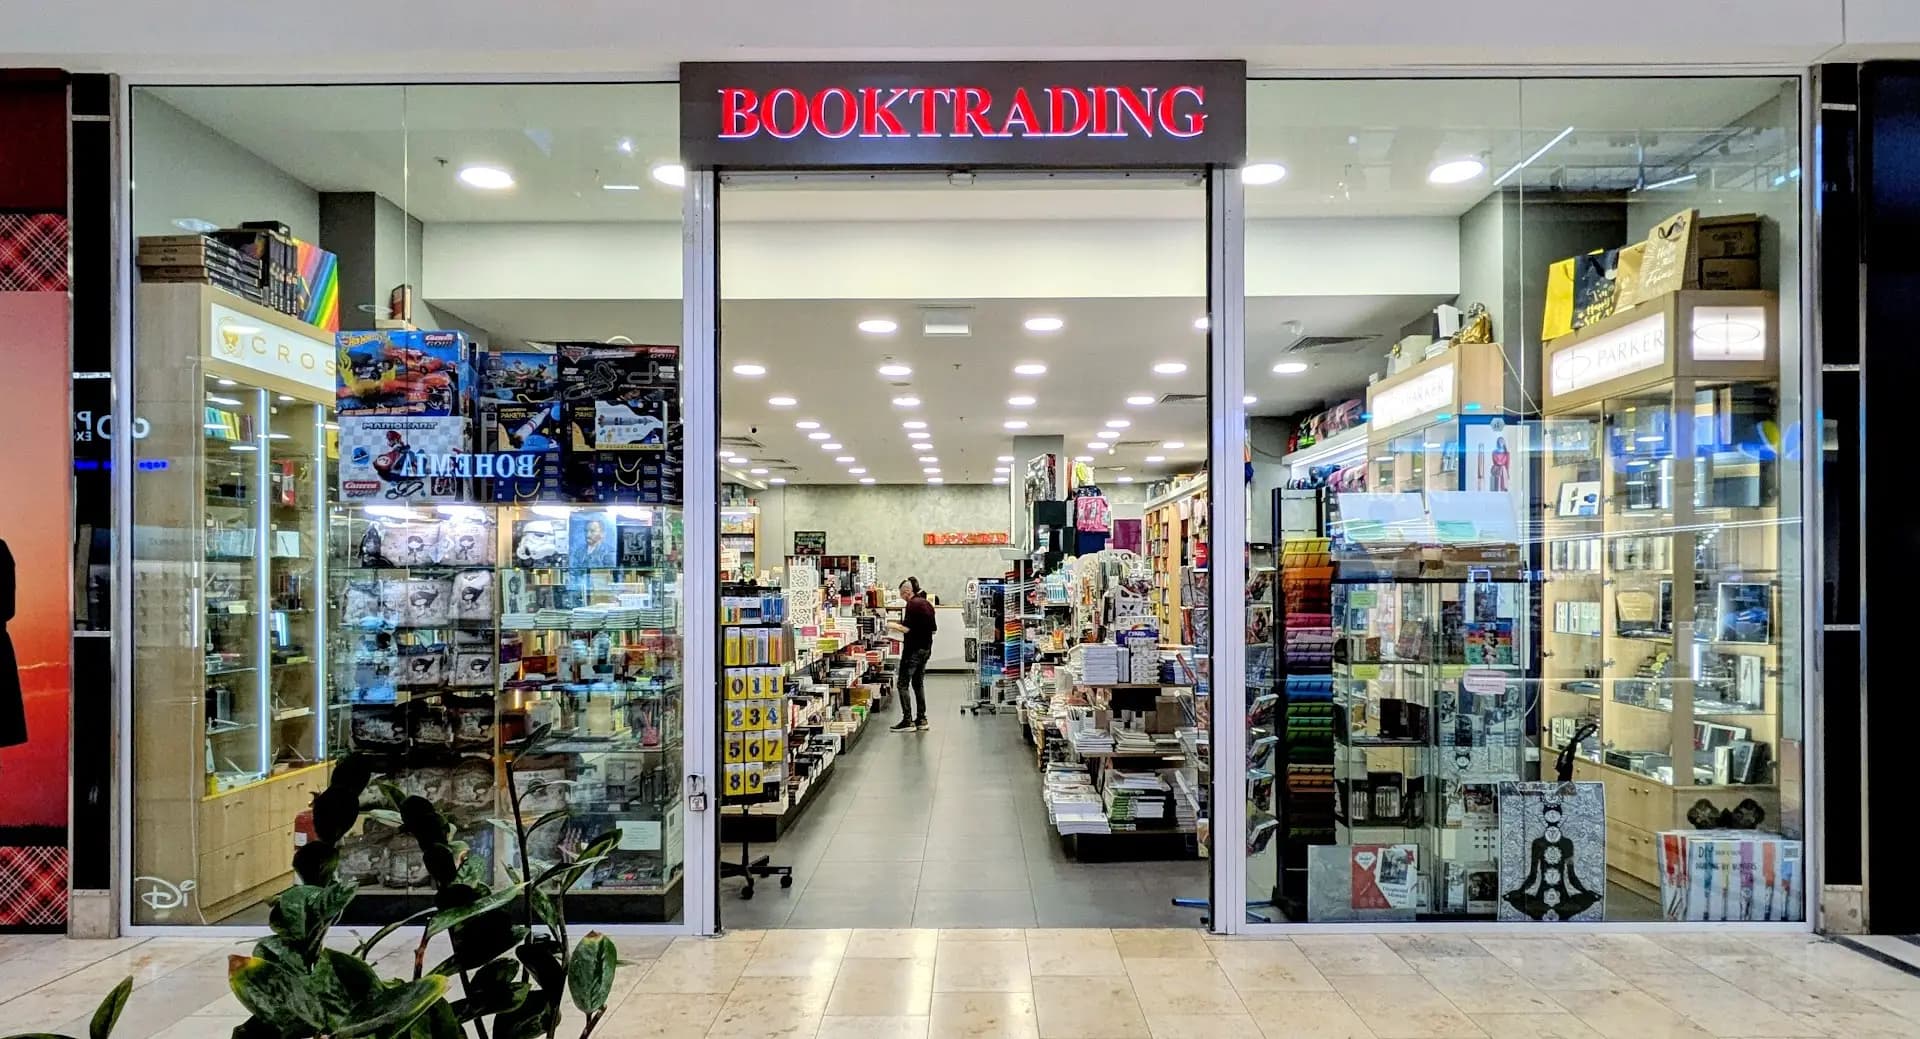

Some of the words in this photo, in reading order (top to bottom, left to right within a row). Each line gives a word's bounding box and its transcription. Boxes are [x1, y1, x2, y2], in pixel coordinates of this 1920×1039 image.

[717, 86, 1208, 138] BOOKTRADING
[251, 336, 336, 377] CROS
[1597, 329, 1665, 367] PARKER
[732, 678, 744, 695] 0
[752, 677, 761, 694] 1
[731, 709, 743, 727] 2
[749, 708, 760, 726] 3
[767, 707, 778, 725] 4
[729, 741, 740, 758] 5
[749, 740, 760, 758] 6
[767, 740, 779, 756] 7
[730, 773, 740, 791] 8
[749, 773, 760, 789] 9
